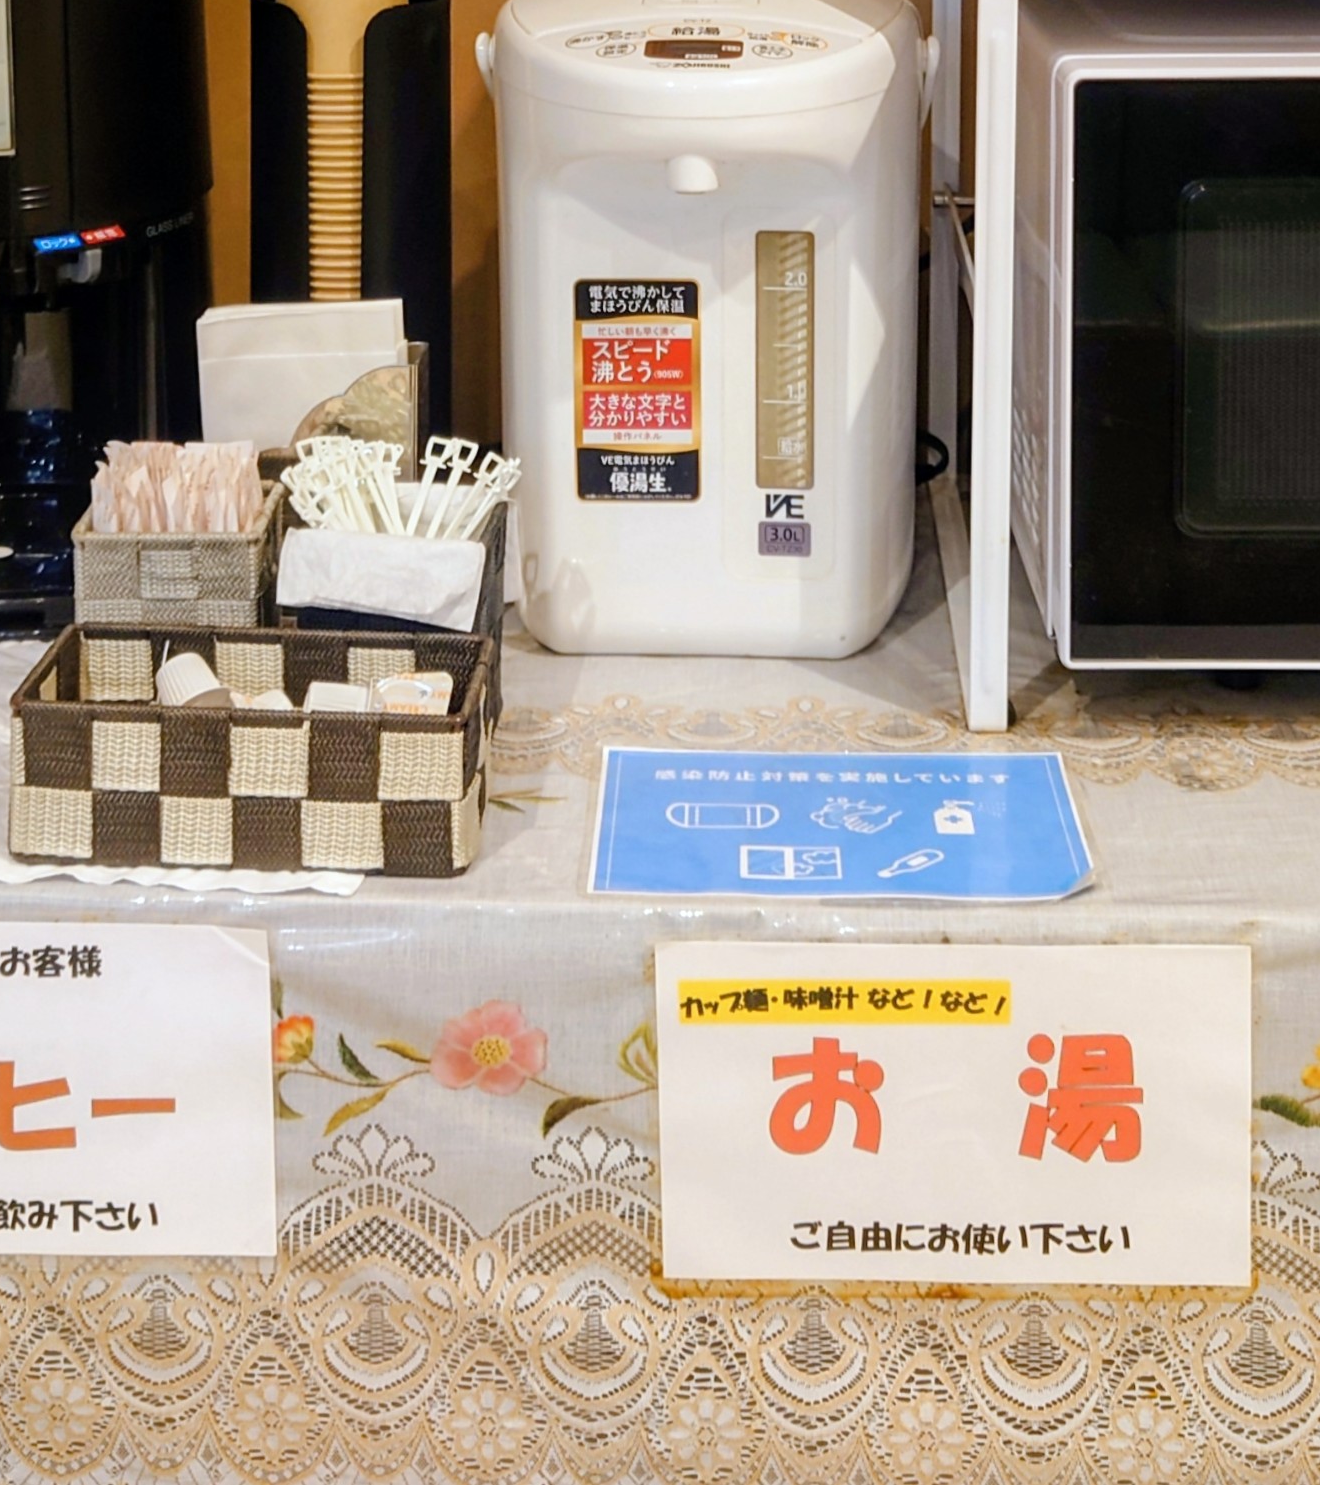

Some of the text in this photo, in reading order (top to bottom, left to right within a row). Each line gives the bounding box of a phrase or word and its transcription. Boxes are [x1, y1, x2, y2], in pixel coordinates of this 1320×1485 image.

[784, 271, 807, 287] 2.0
[588, 285, 686, 300] 電気で沸かして
[589, 300, 686, 314] まほうびん保温
[591, 339, 670, 361] スピード
[588, 393, 686, 411] 大きな文字と
[588, 411, 687, 428] 分かりやすい
[600, 455, 676, 466] VE電気まほうびん
[654, 769, 1011, 785] 感染防止対策を実施しています
[789, 1221, 1131, 1255] ご自由にお使い下さい
